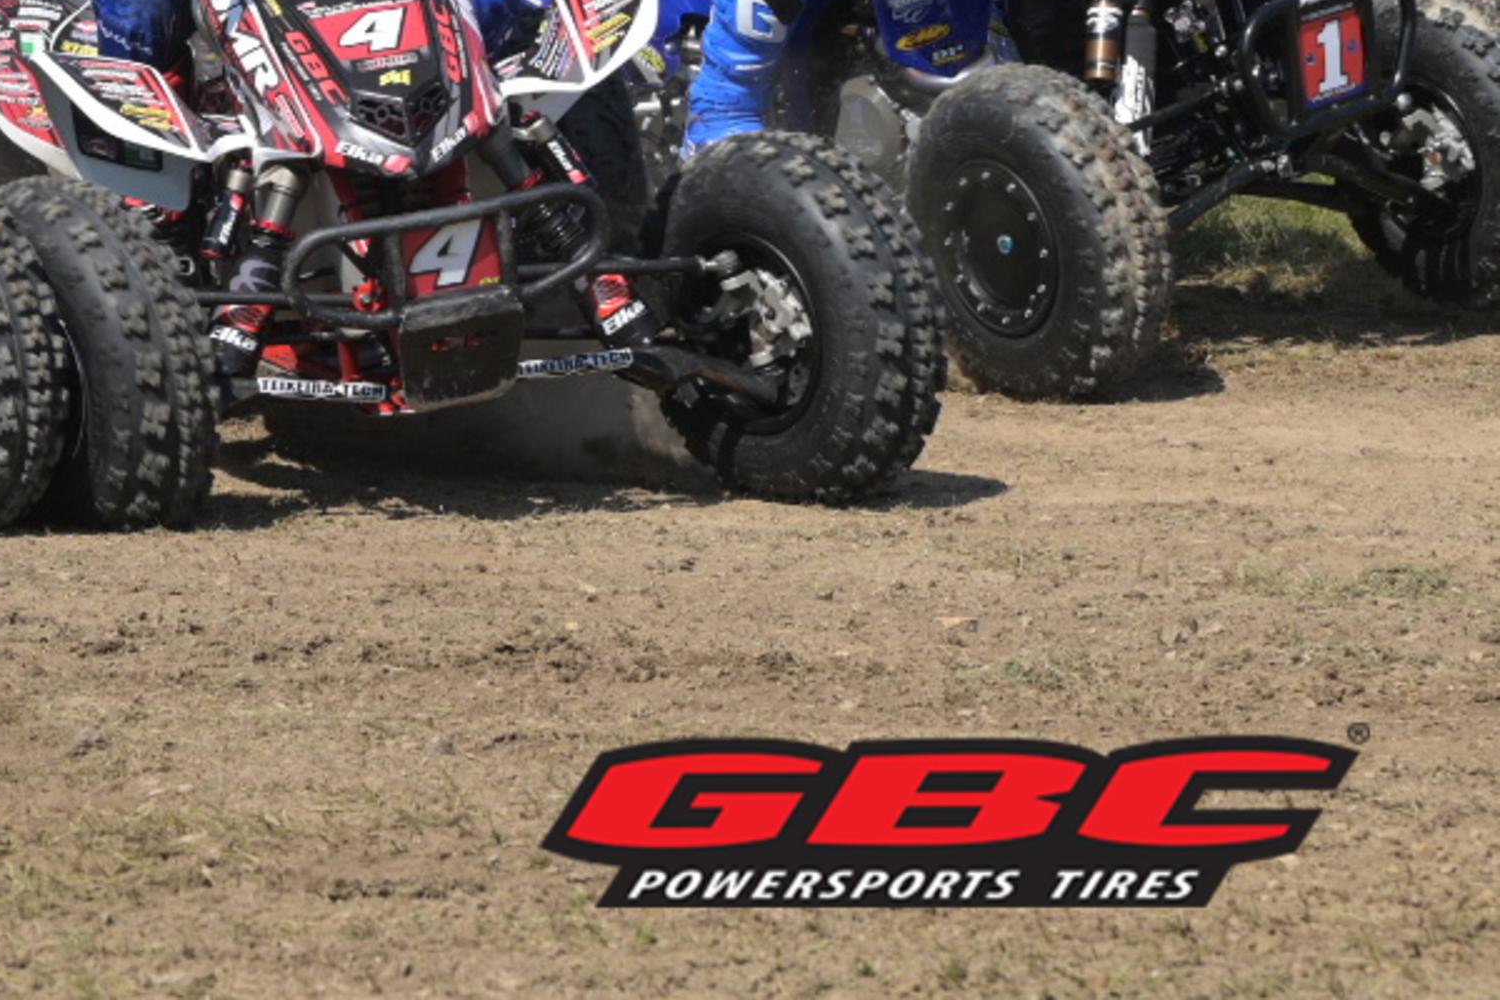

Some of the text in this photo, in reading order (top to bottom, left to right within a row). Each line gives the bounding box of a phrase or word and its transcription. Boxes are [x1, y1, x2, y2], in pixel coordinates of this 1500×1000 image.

[338, 7, 405, 52] 4
[285, 29, 350, 106] GBC
[1316, 20, 1350, 93] 1
[336, 141, 385, 165] Elka
[409, 218, 484, 288] 4
[209, 324, 257, 352] Elka
[601, 300, 648, 336] Elka
